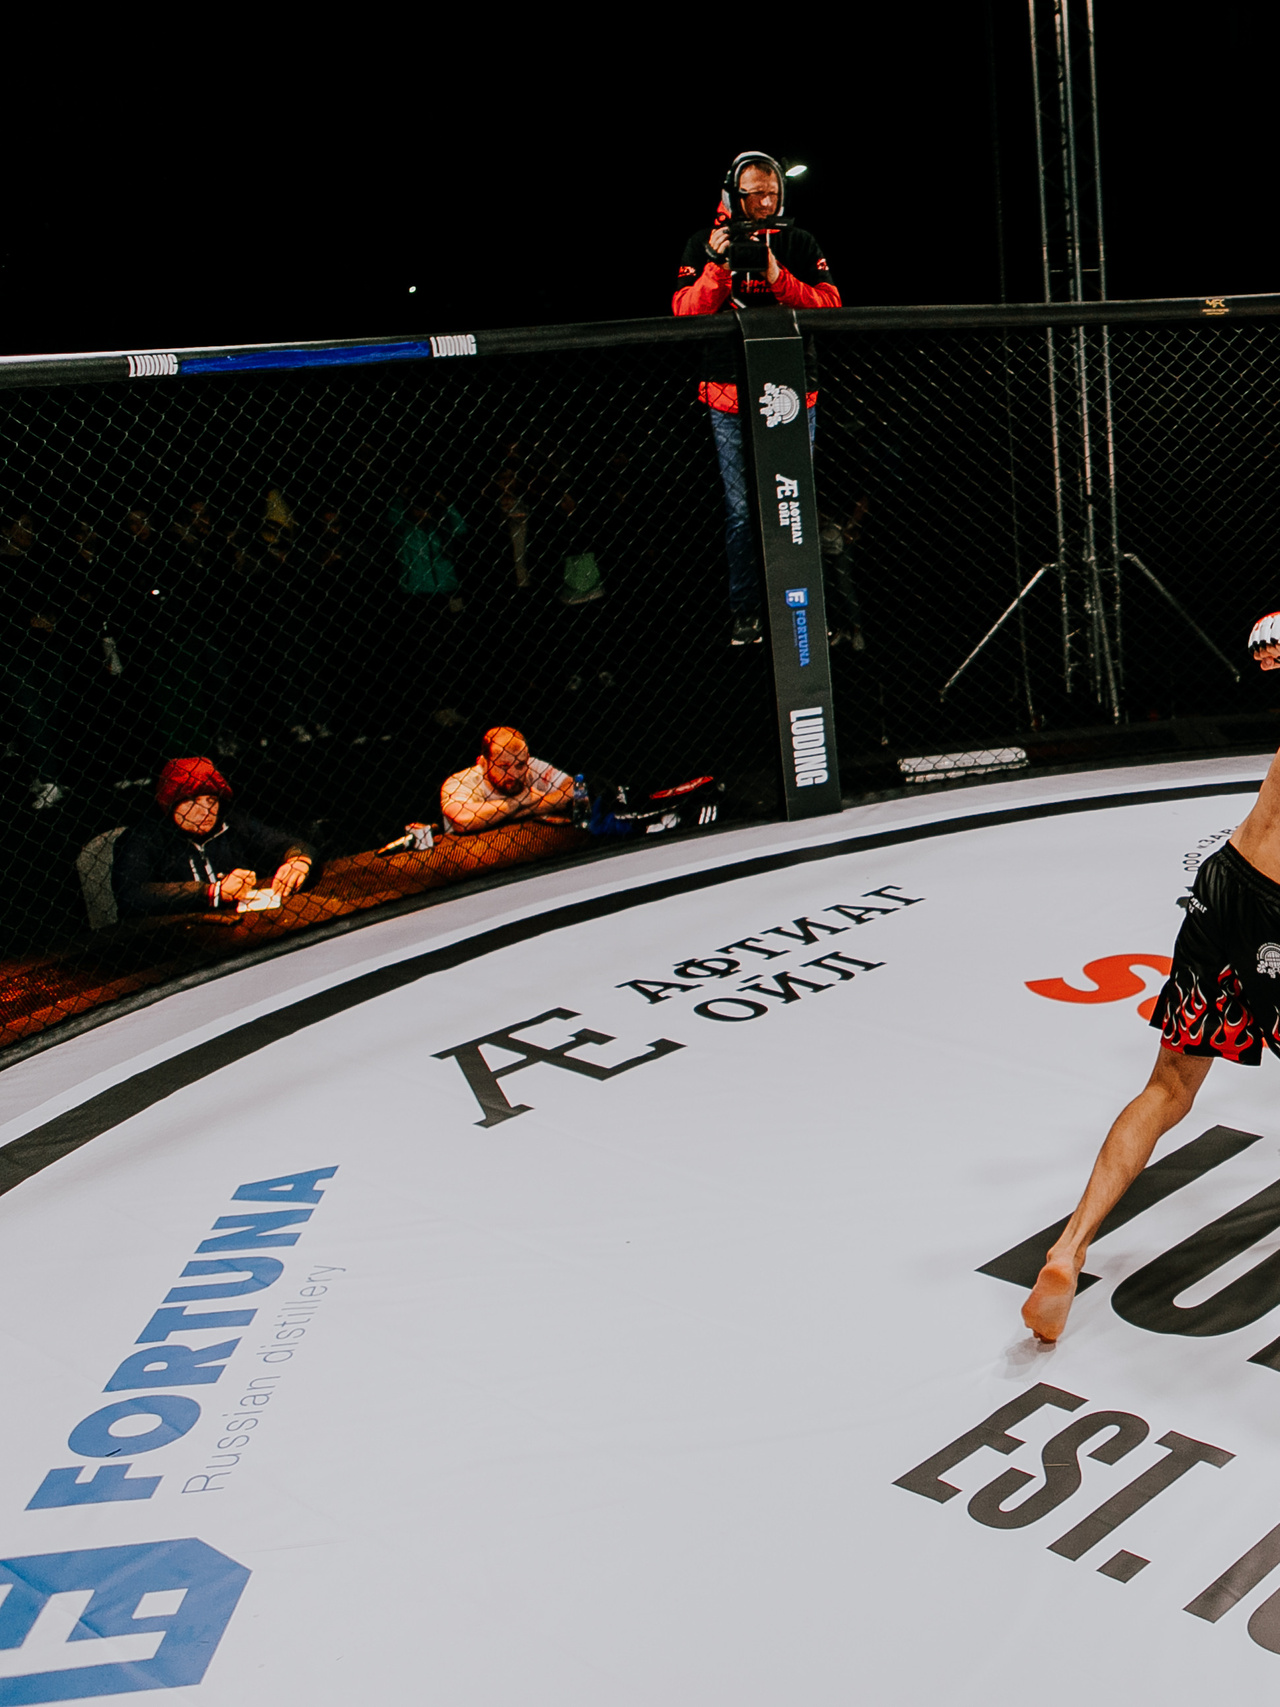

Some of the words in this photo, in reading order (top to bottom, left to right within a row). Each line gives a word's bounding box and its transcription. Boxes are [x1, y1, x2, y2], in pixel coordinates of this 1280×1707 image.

[127, 353, 178, 377] LUDING
[430, 334, 477, 358] LUDING
[796, 609, 811, 667] FORTUNA
[789, 706, 829, 788] LUDING
[614, 885, 926, 1004] АФТИАГ
[693, 951, 887, 1022] ОЙЛ
[24, 1165, 340, 1511] FORTUNA
[181, 1375, 282, 1494] Russian
[256, 1265, 346, 1364] distillery
[891, 1382, 1152, 1583] EST.
